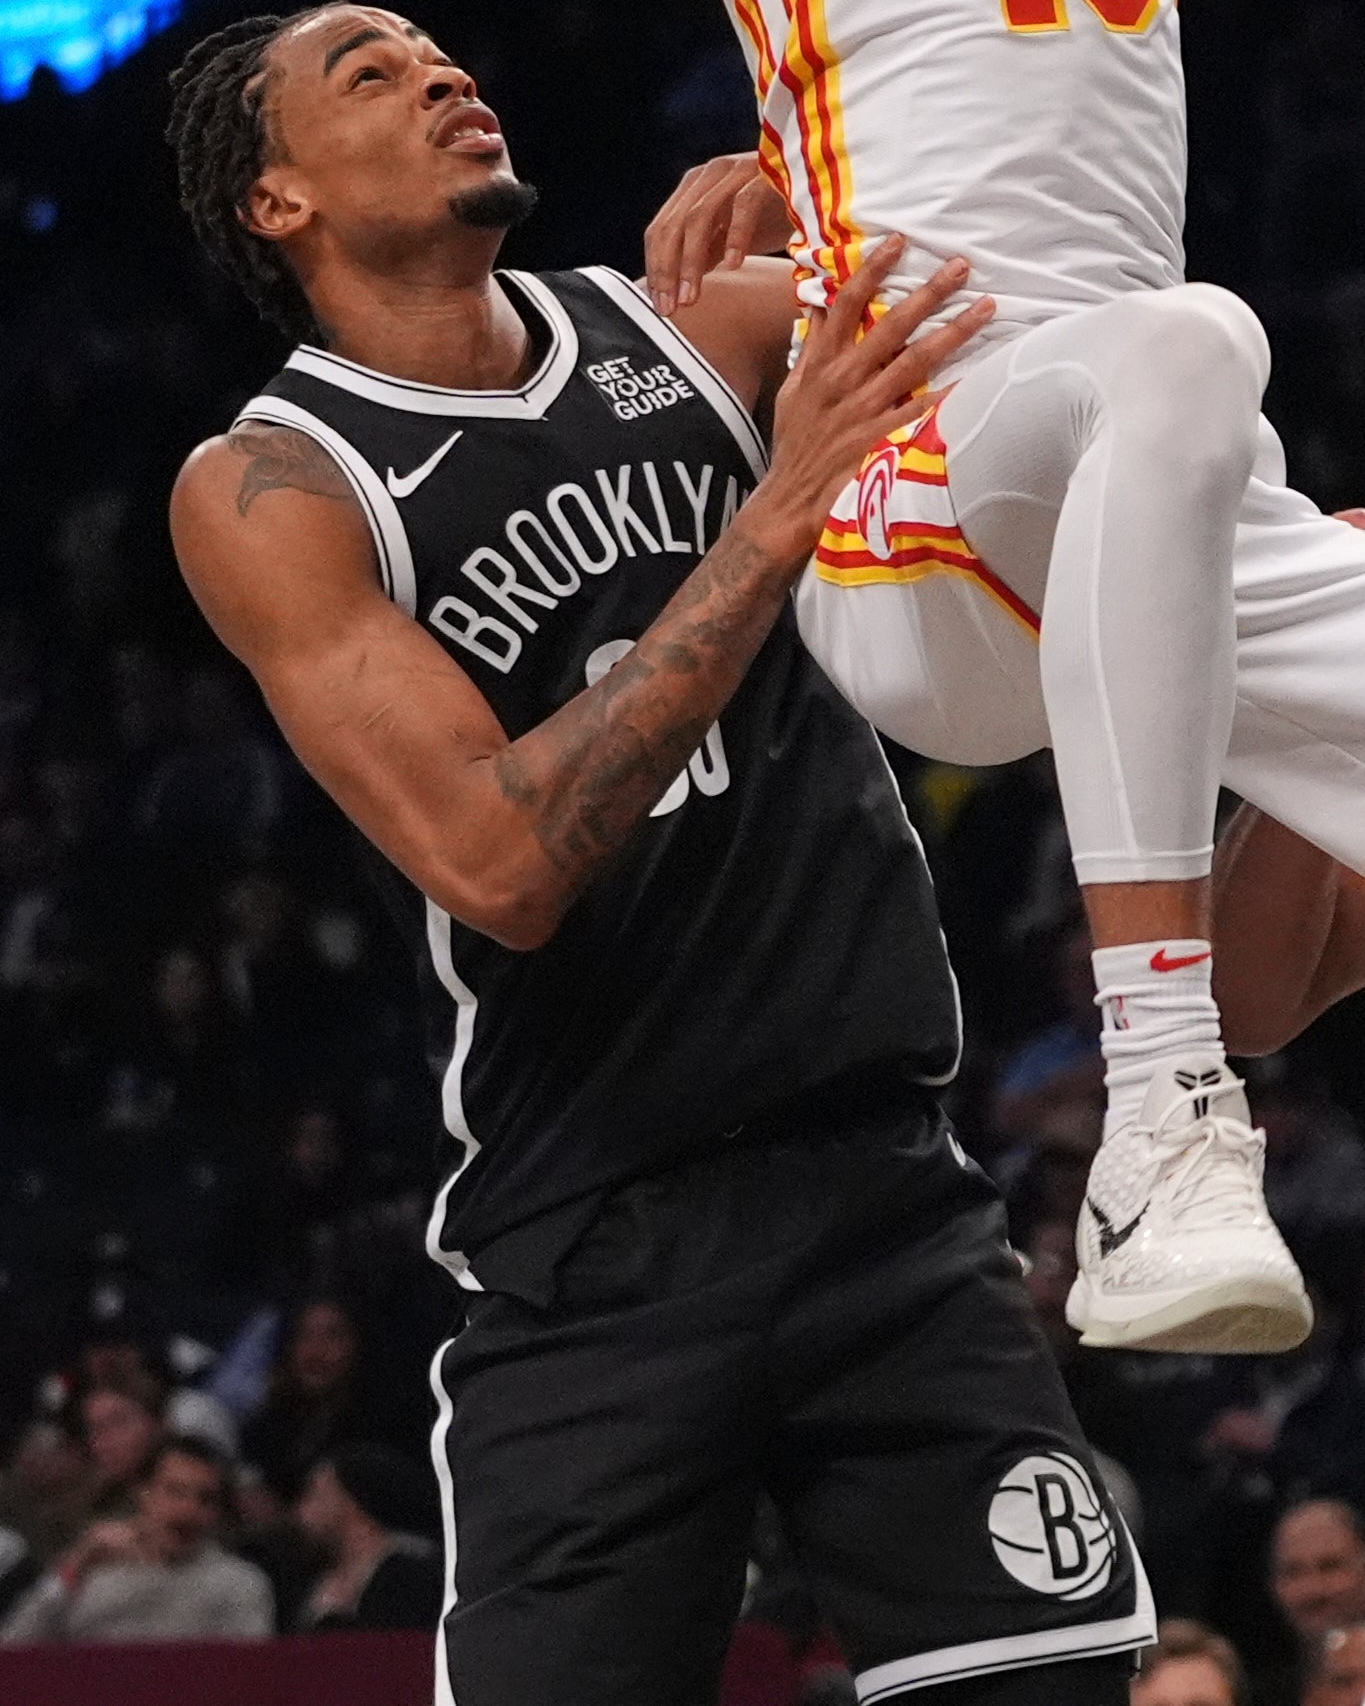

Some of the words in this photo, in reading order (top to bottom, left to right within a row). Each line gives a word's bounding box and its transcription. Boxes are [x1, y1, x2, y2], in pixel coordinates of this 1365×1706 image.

[587, 356, 635, 383] GET
[599, 364, 677, 401] YOUR
[614, 379, 695, 421] GUIDE
[1034, 1472, 1089, 1580] B
